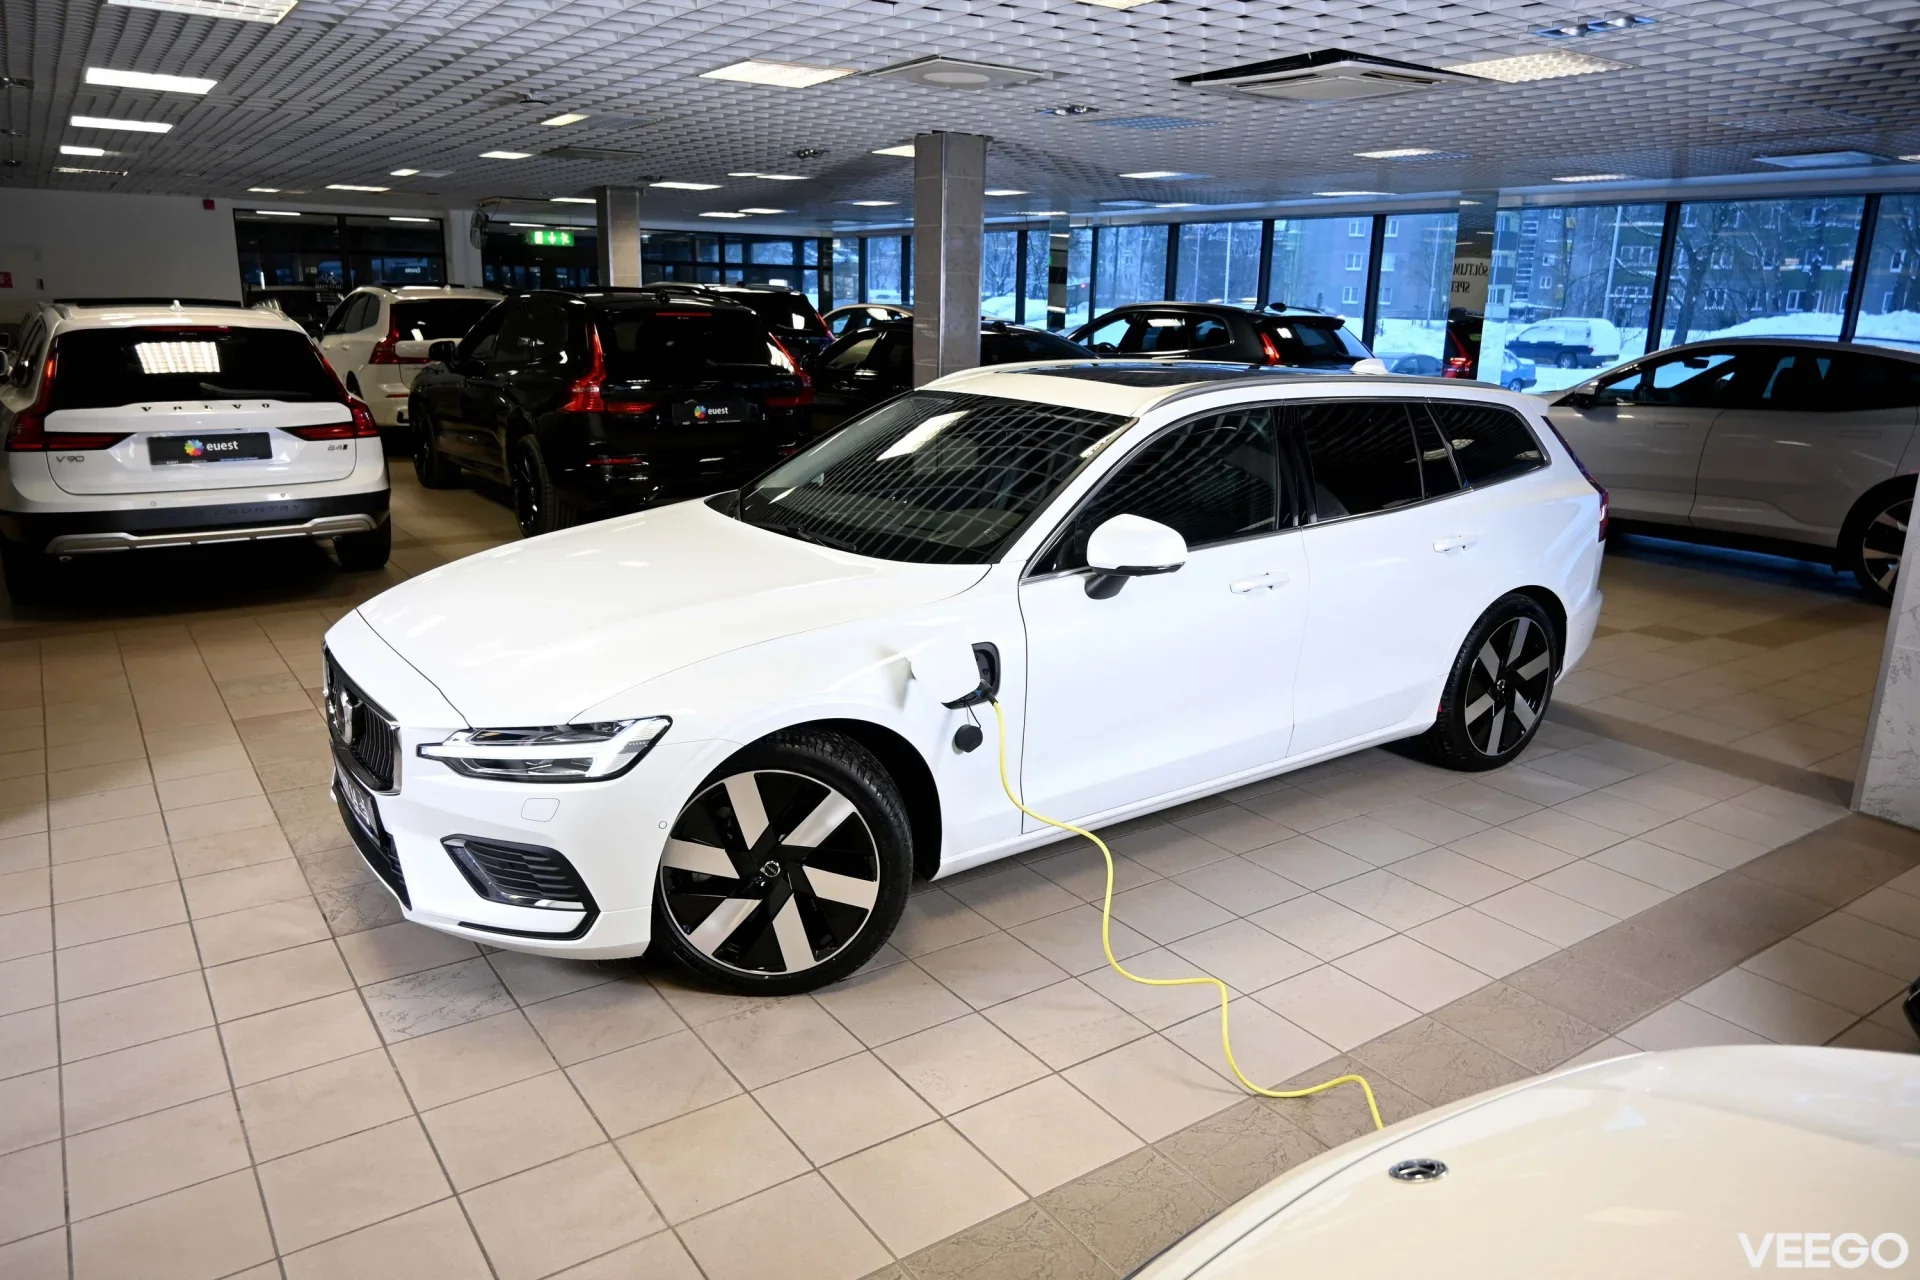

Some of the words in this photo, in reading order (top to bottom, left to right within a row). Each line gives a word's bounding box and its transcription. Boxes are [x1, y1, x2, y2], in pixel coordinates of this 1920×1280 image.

[141, 403, 270, 412] VOLVO
[707, 407, 729, 415] euest
[206, 440, 239, 452] euest
